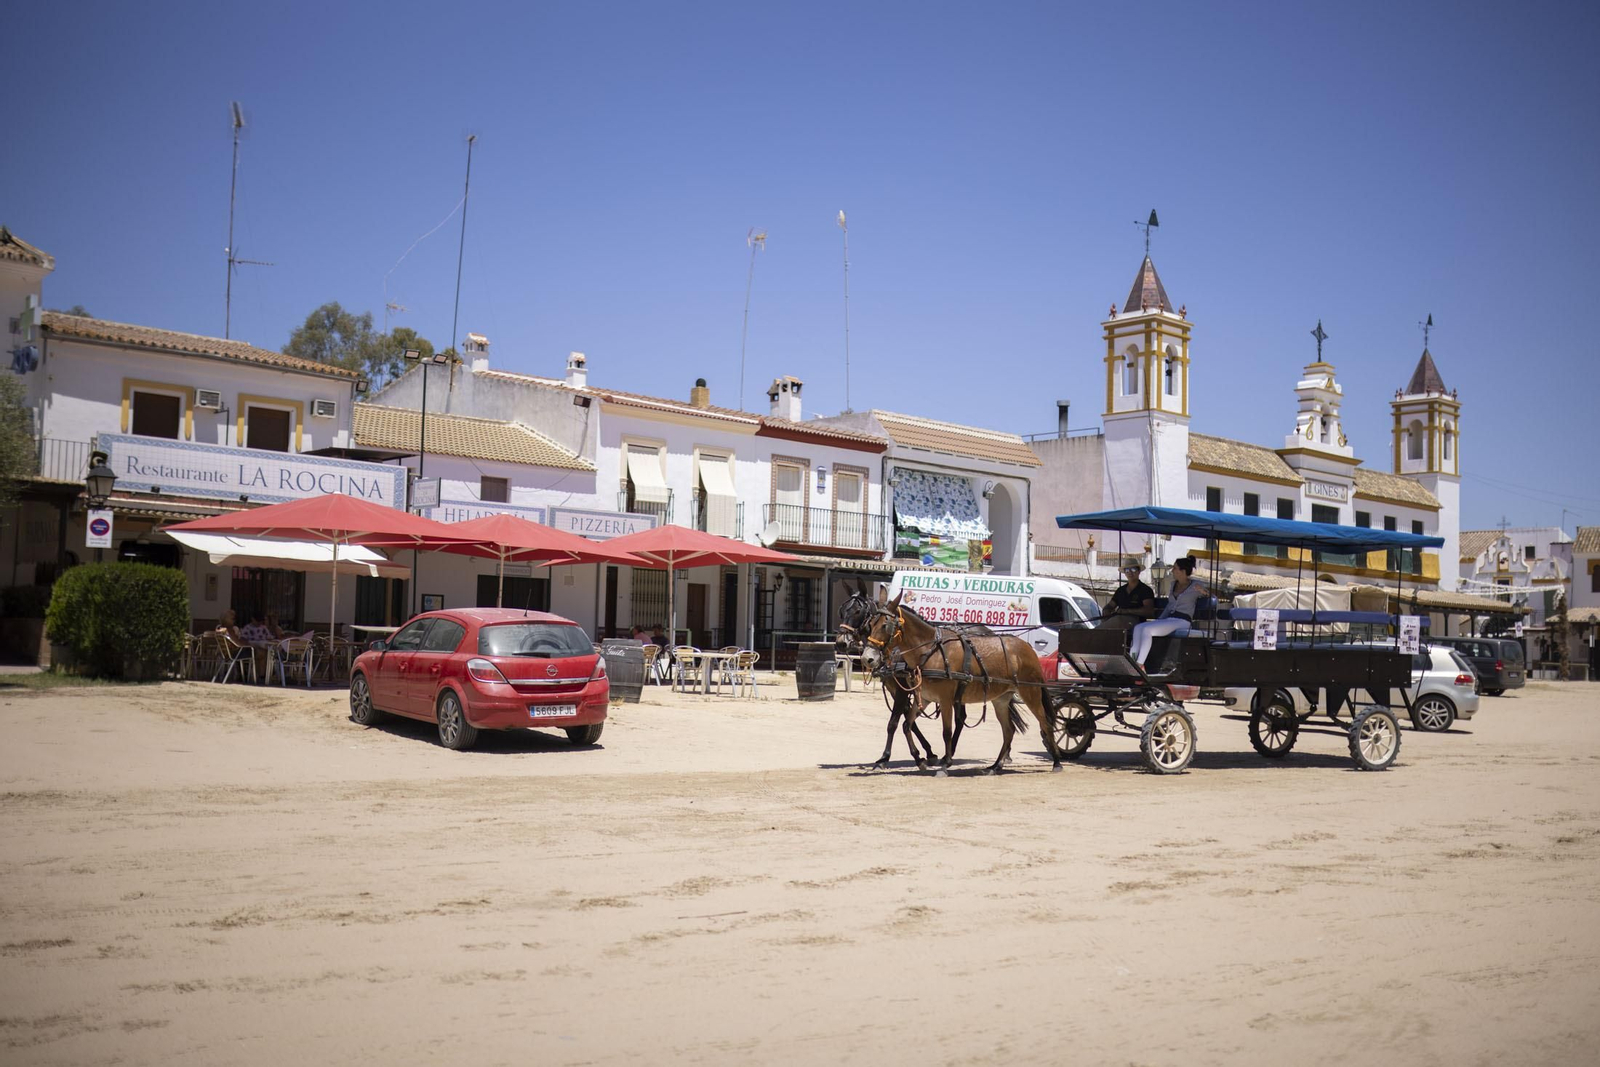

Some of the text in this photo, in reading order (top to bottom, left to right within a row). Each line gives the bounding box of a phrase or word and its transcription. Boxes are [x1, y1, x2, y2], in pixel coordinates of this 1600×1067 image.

[126, 455, 383, 500] Restaurante LA ROCINA
[1314, 483, 1339, 498] GINES
[571, 516, 635, 535] PIZZERÍA
[901, 575, 949, 590] FRUTAS
[964, 578, 1034, 594] VERDURAS
[921, 593, 942, 604] Pedro
[946, 595, 963, 605] José
[918, 606, 937, 621] 639
[985, 610, 1005, 625] 898
[1008, 611, 1028, 626] 877
[535, 706, 557, 716] 5609
